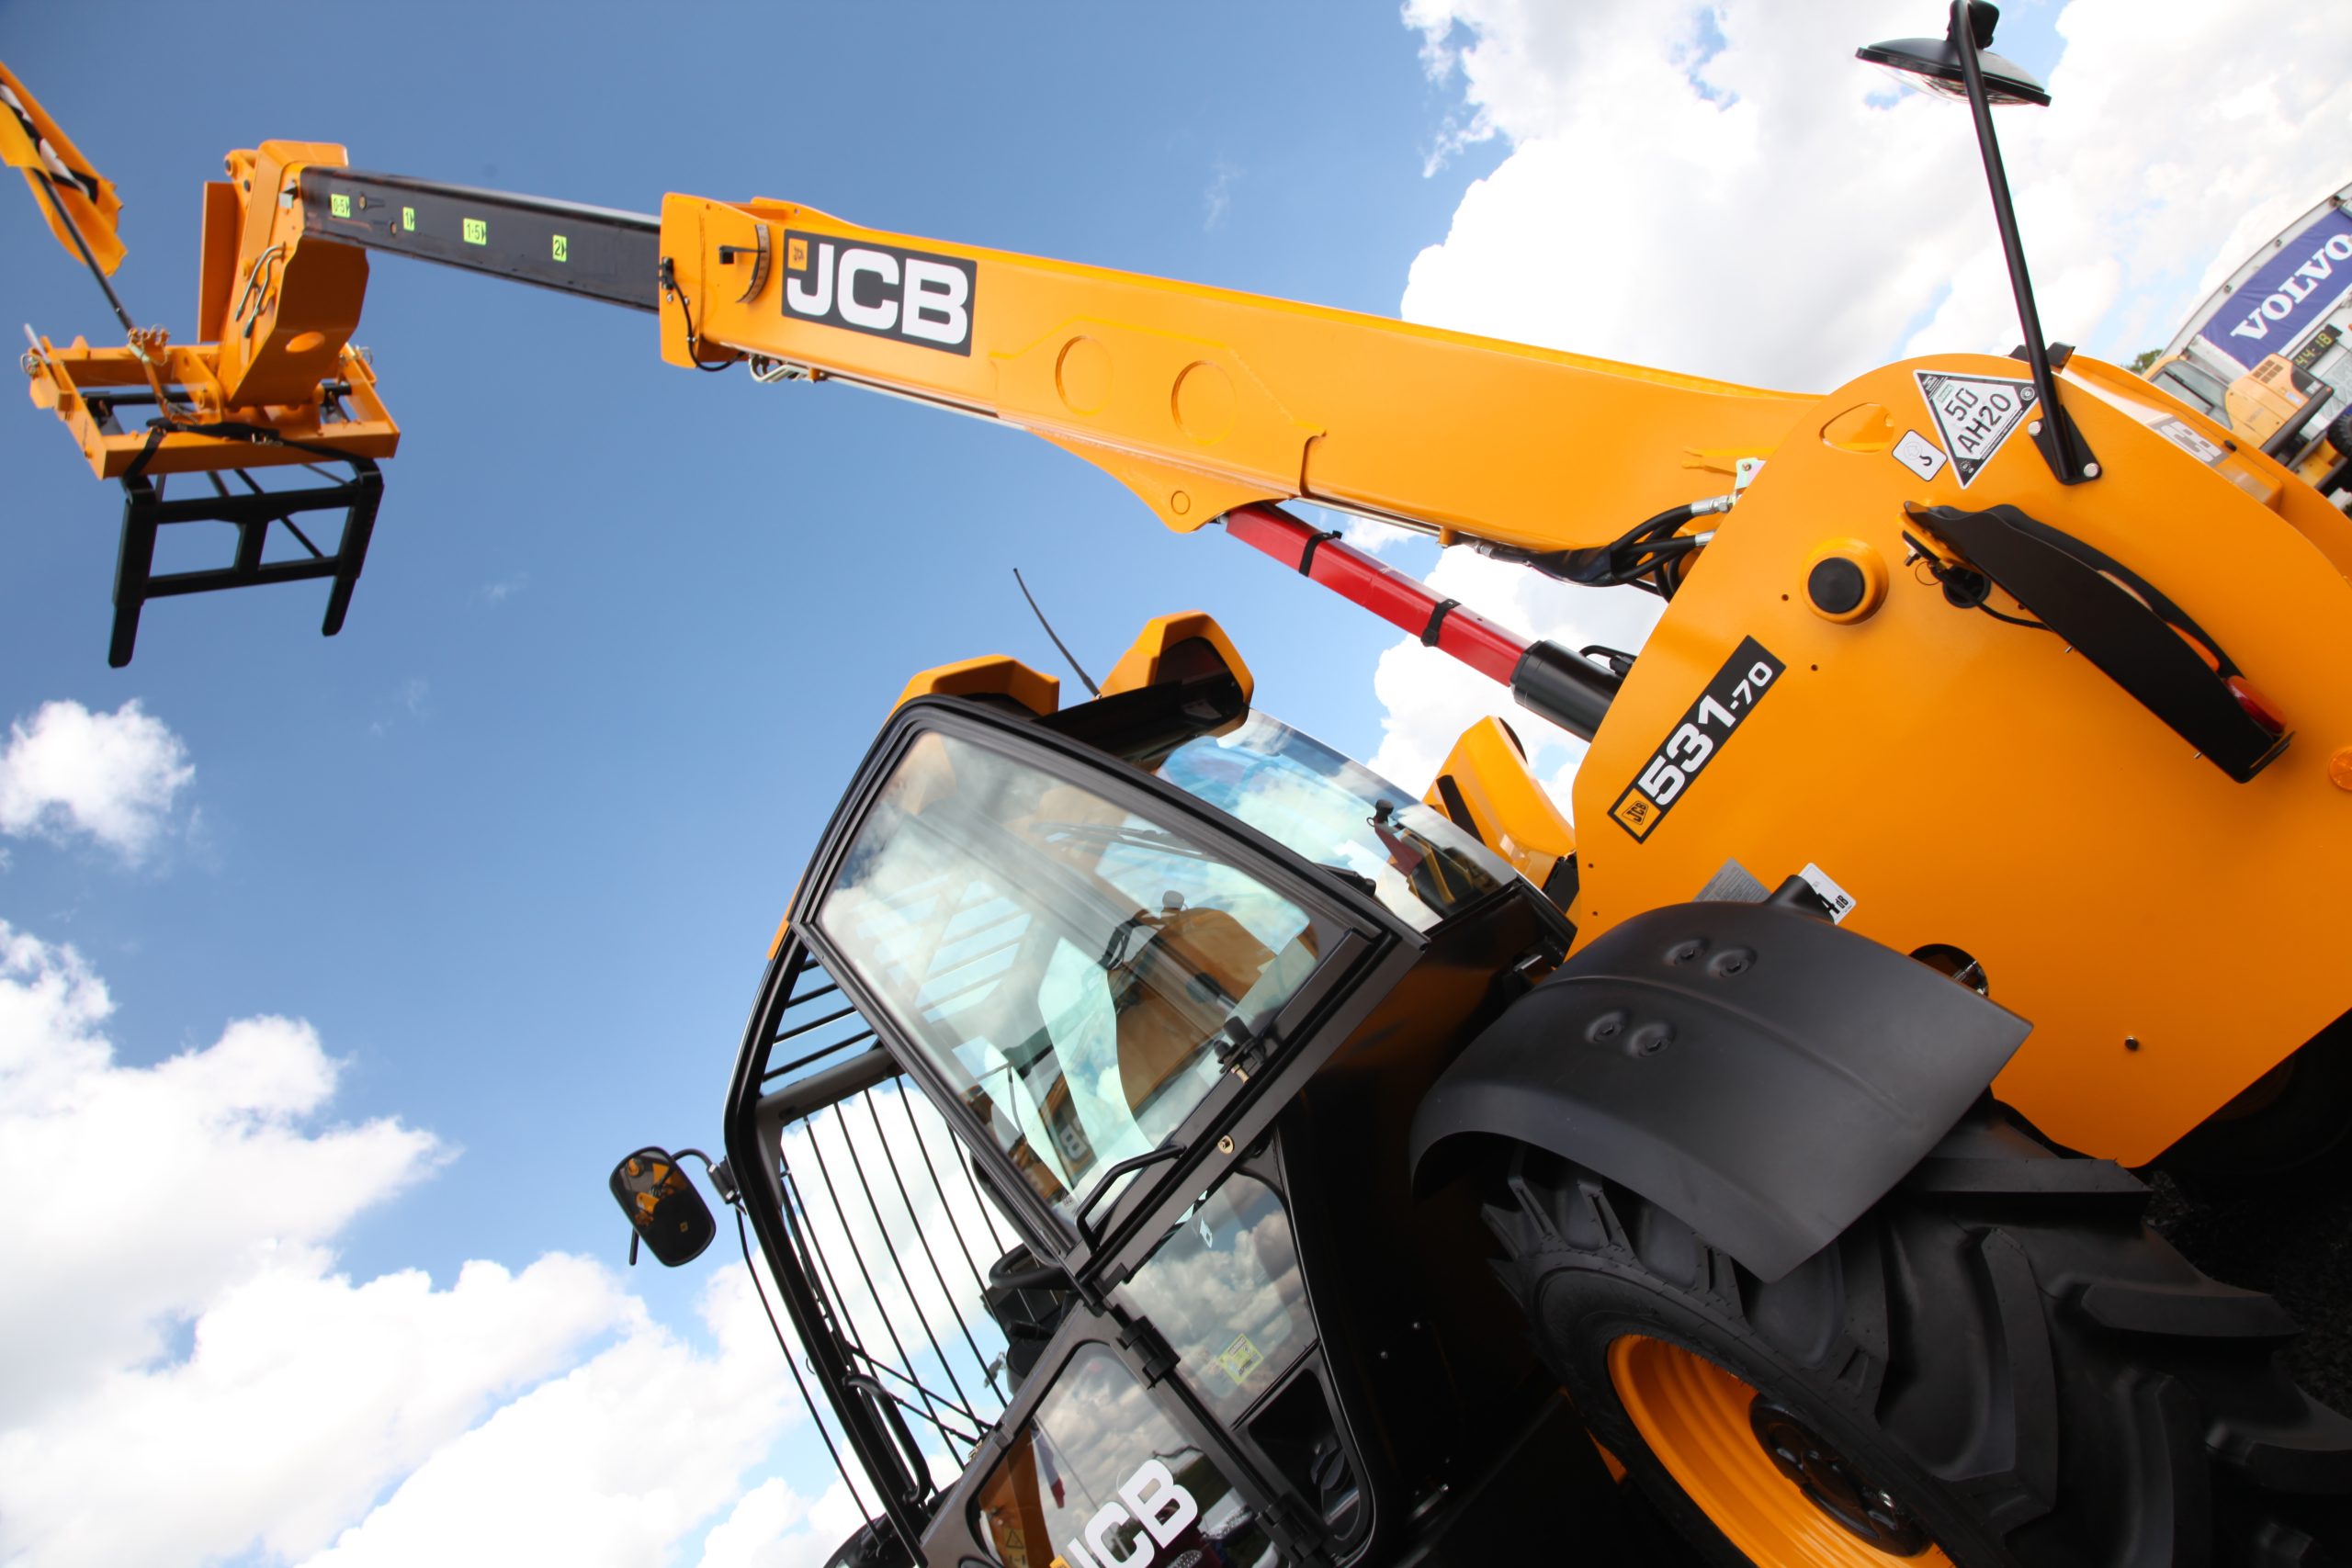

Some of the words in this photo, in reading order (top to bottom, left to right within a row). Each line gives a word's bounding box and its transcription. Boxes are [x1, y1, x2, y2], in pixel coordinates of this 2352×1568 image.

[554, 240, 561, 257] 2
[2230, 233, 2352, 340] VOLVO
[786, 243, 968, 344] JCB
[1957, 393, 2012, 454] AH20
[1625, 800, 1649, 823] JCB
[1637, 661, 1773, 806] 531-70
[1835, 895, 1849, 908] dB
